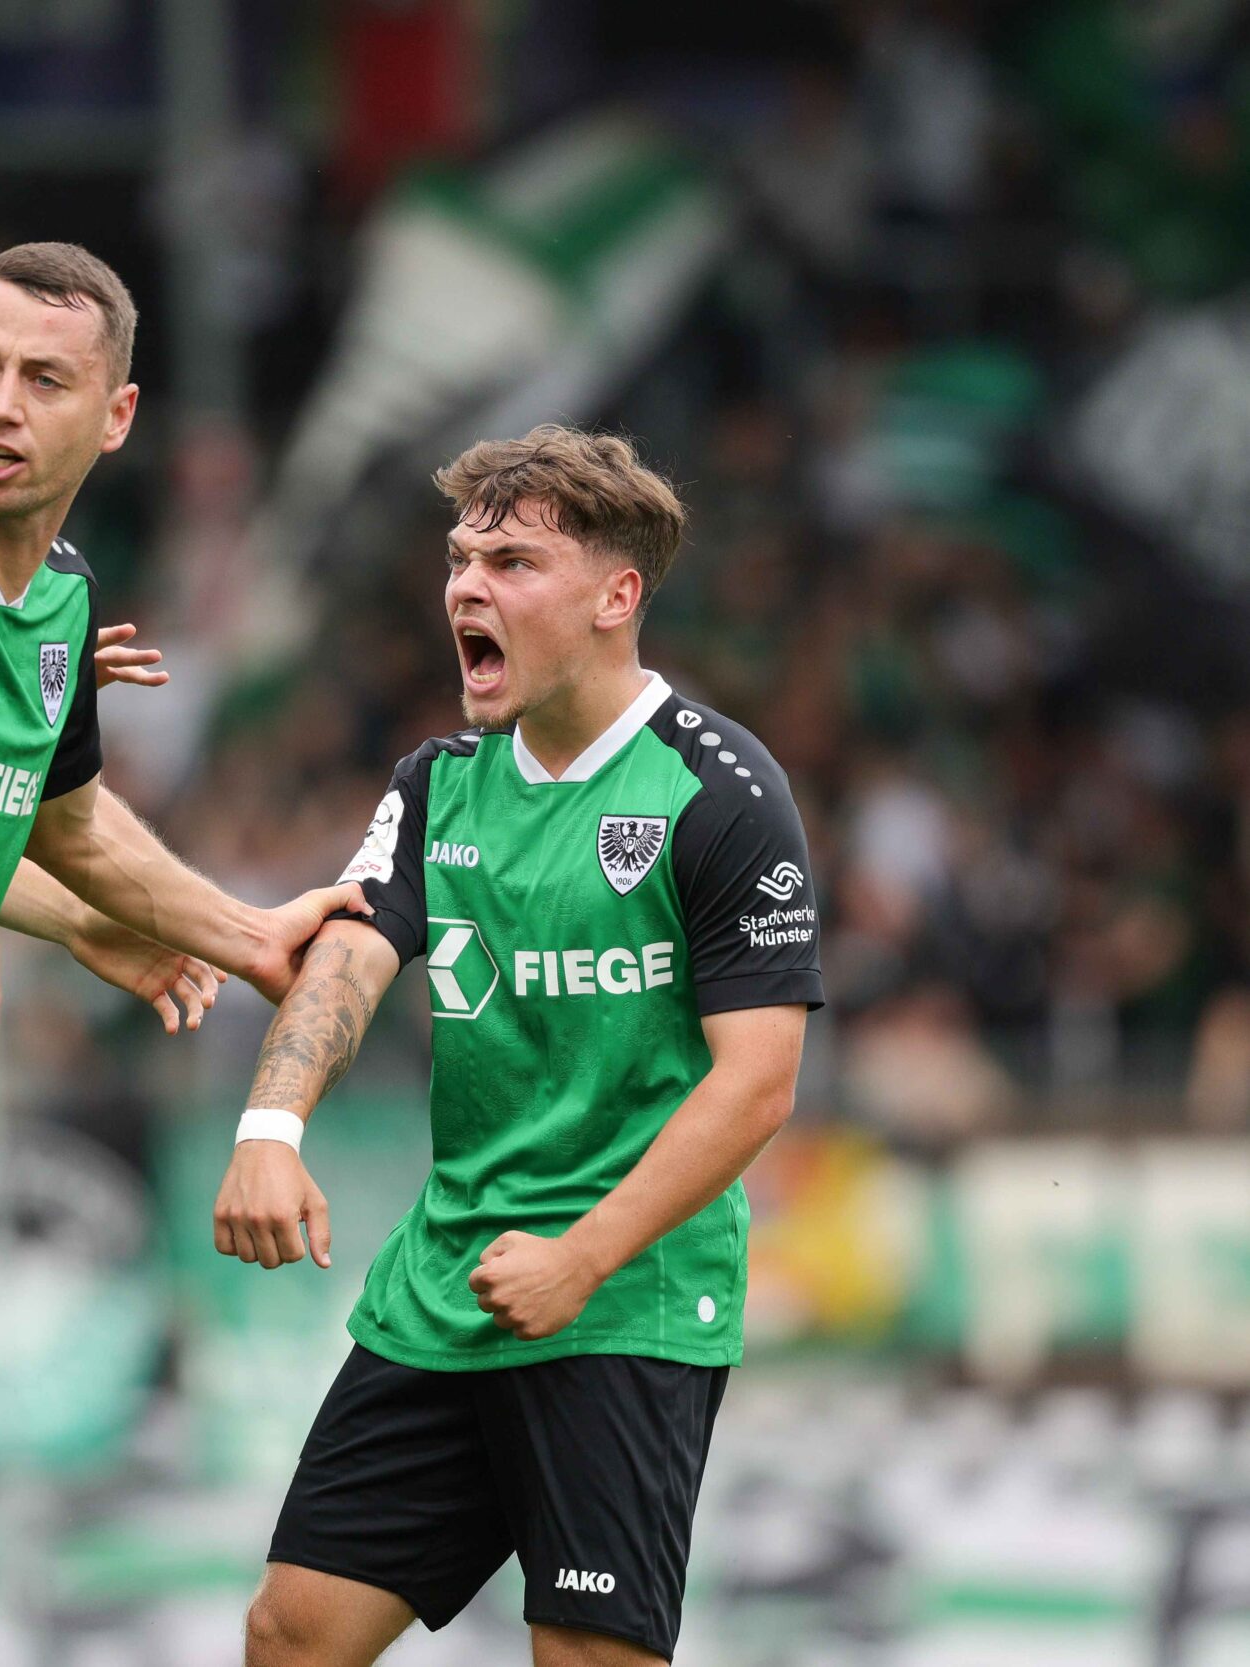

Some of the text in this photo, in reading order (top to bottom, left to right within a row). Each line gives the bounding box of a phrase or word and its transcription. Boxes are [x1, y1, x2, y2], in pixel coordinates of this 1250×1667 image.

[425, 840, 480, 868] JAKO
[615, 877, 632, 886] 1906
[750, 926, 814, 947] Münster
[514, 941, 674, 996] FIEGE
[555, 1568, 615, 1594] JAKO
